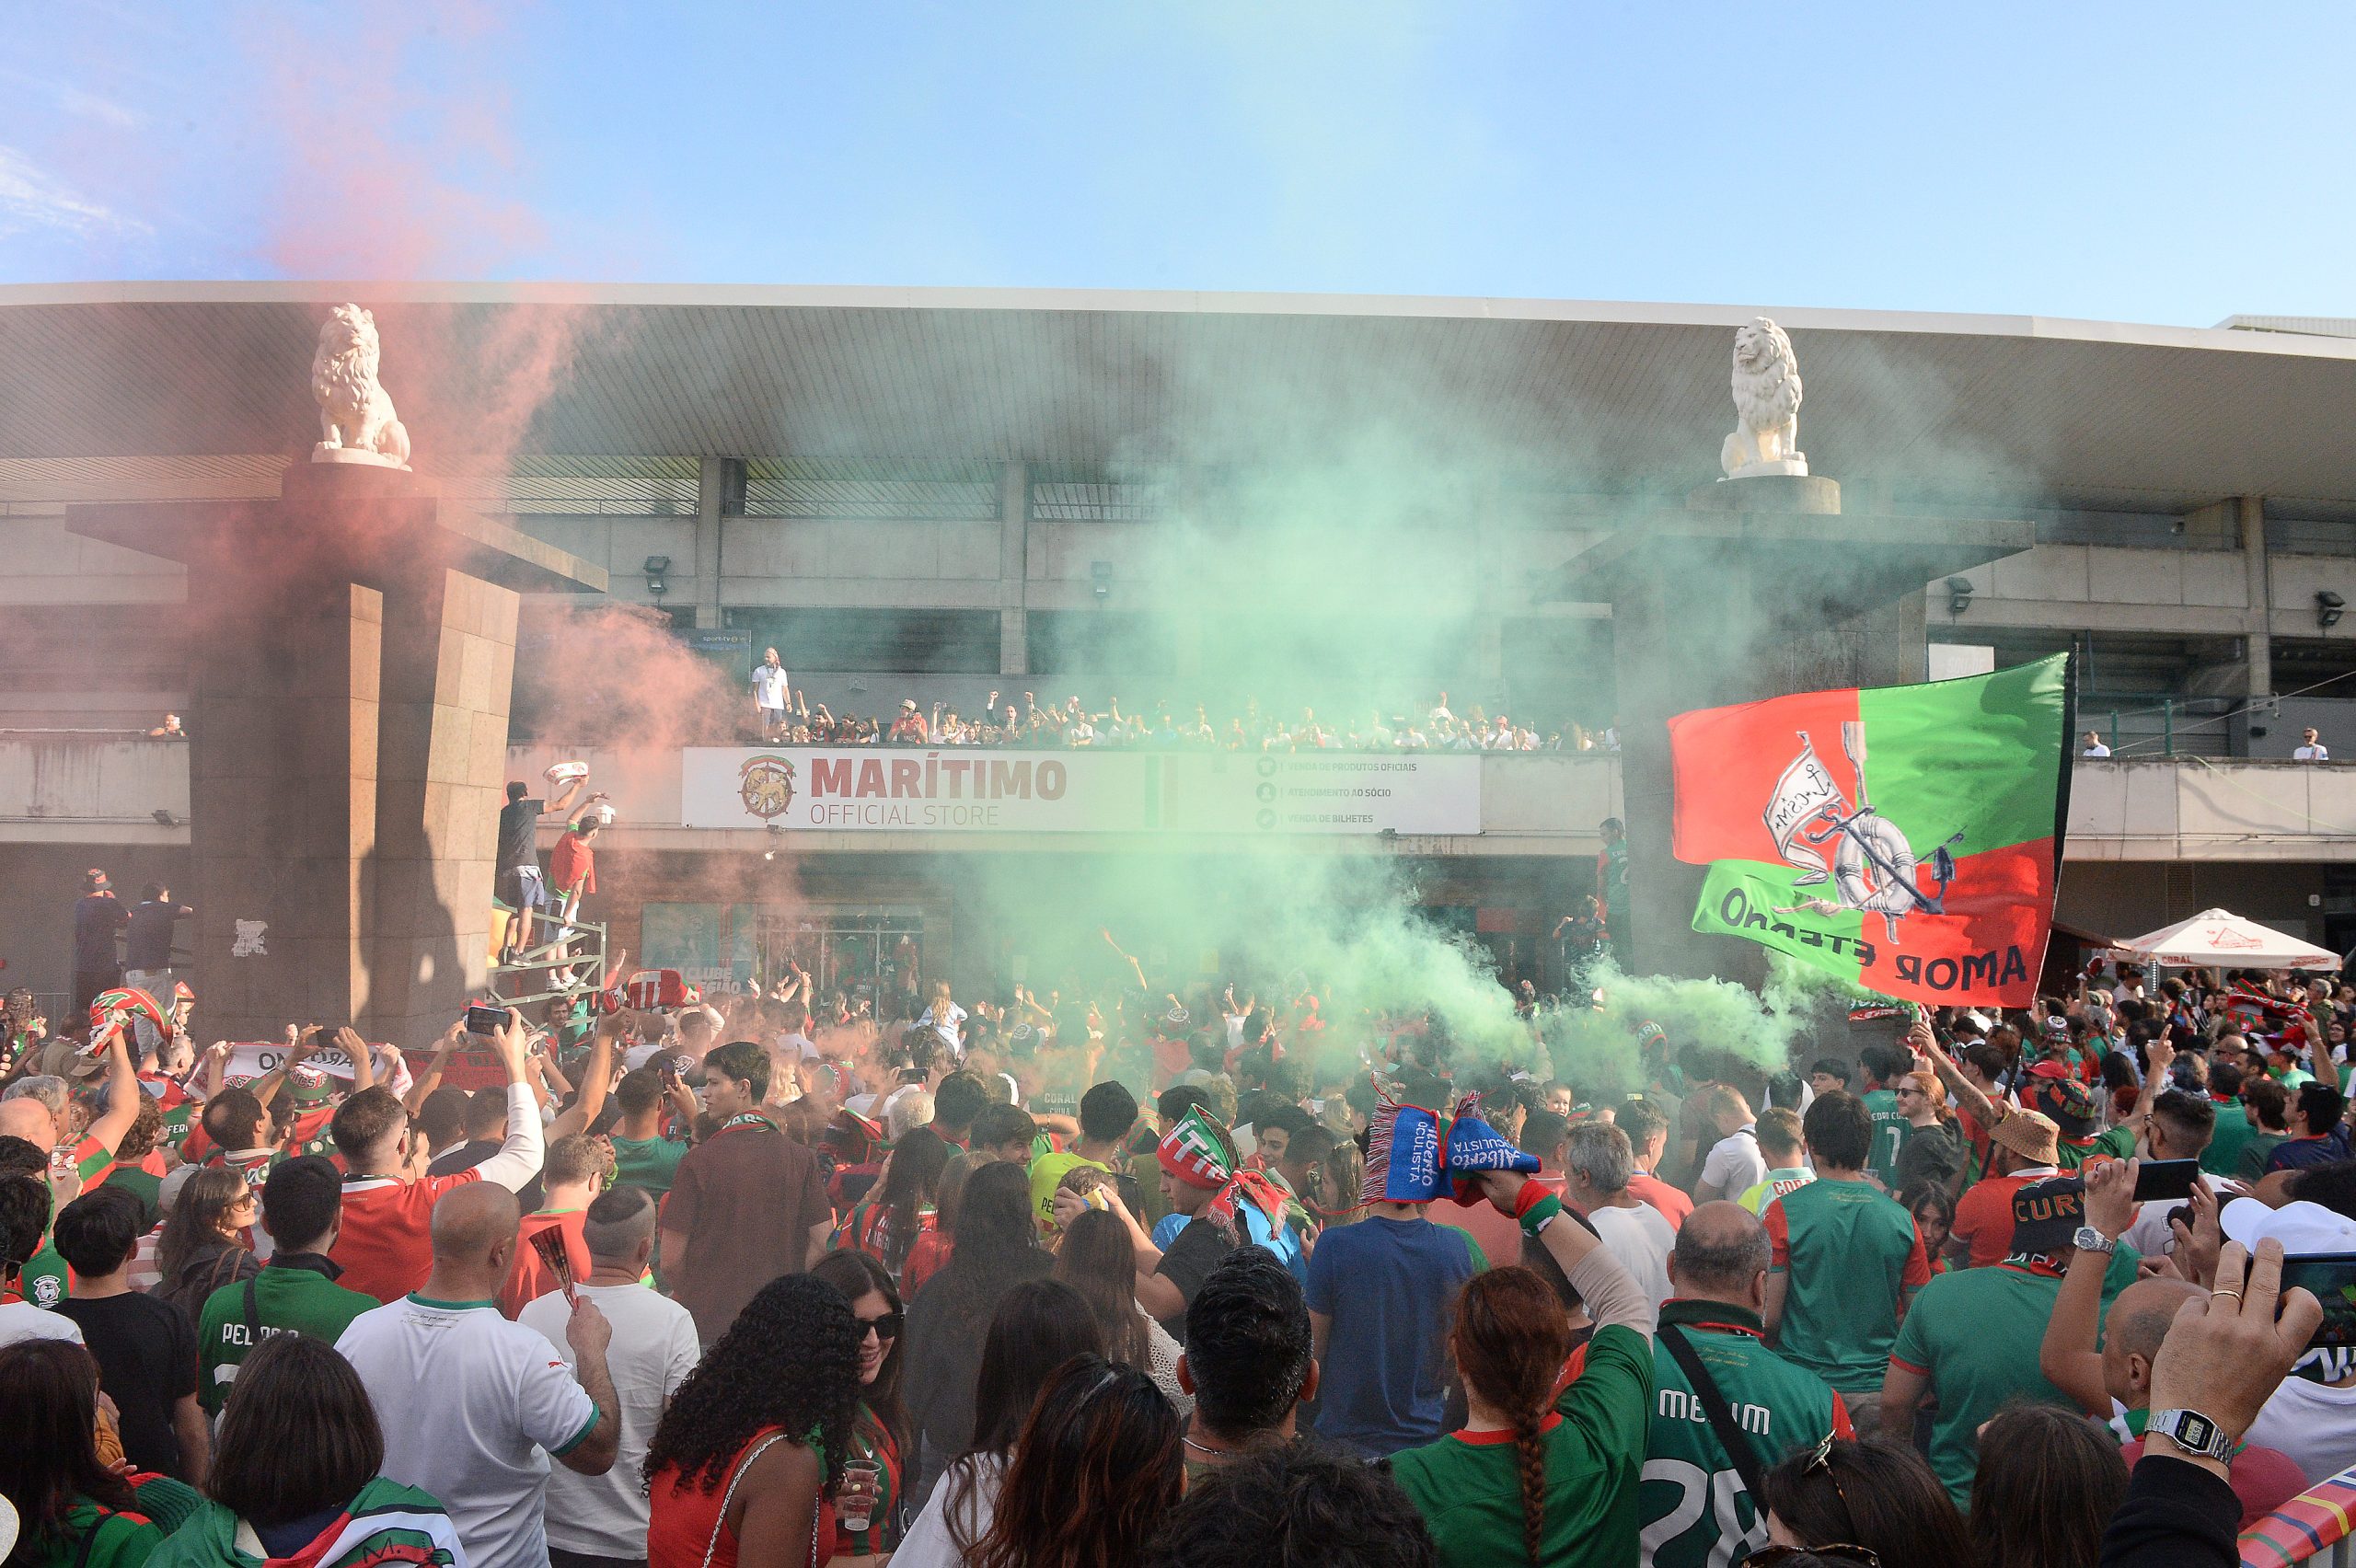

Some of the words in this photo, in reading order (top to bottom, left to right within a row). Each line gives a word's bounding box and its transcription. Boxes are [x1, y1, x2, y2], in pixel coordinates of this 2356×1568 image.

[1288, 763, 1317, 771] VENDA
[1320, 763, 1329, 771] DE
[1332, 763, 1379, 771] PRODUTOS
[1380, 763, 1417, 771] OFICIAIS
[811, 752, 1067, 801] MARÍTIMO
[1288, 789, 1350, 797] ATENDIMENTO
[1352, 789, 1363, 797] AO
[1365, 787, 1392, 797] SÓCIO
[810, 804, 916, 824] OFFICIAL
[923, 805, 999, 824] STORE
[1288, 814, 1317, 823] VENDA
[1319, 814, 1331, 823] DE
[1333, 814, 1373, 823] BILHETES
[2162, 955, 2192, 964] CORAL
[1045, 1092, 1077, 1104] CORAL
[1409, 1121, 1427, 1182] OCULISTA
[1887, 1126, 1900, 1167] 7
[1451, 1149, 1521, 1170] Alberto
